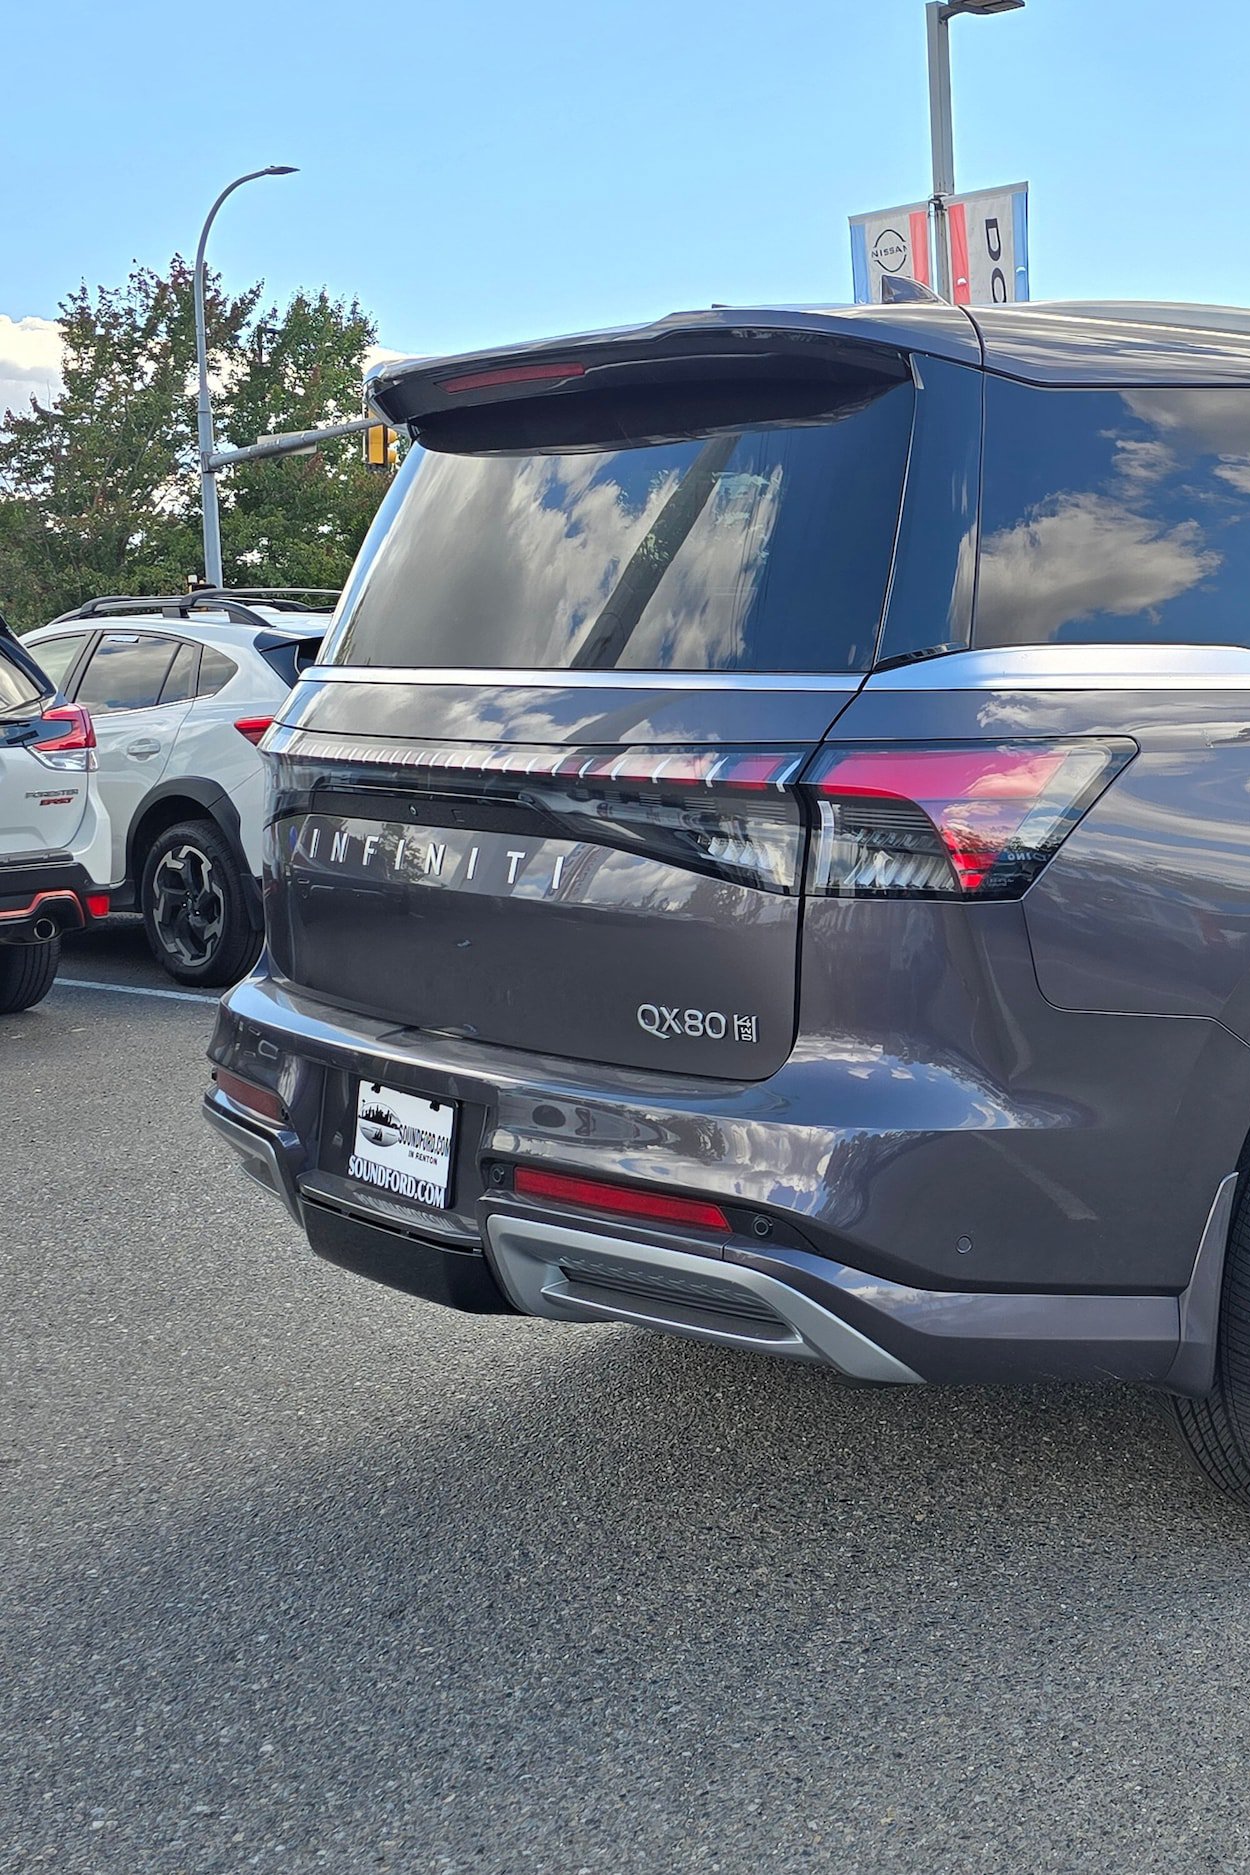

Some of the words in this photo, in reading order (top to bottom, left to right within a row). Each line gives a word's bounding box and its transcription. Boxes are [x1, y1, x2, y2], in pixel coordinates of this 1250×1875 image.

[871, 244, 908, 258] NISSAN
[25, 788, 79, 799] FORESTER
[309, 828, 565, 890] INFINITI
[636, 1003, 726, 1039] QX80
[397, 1124, 450, 1157] SOUNDFORD.COM
[415, 1152, 438, 1165] RENTON
[348, 1154, 446, 1209] SOUNDFORD.COM
